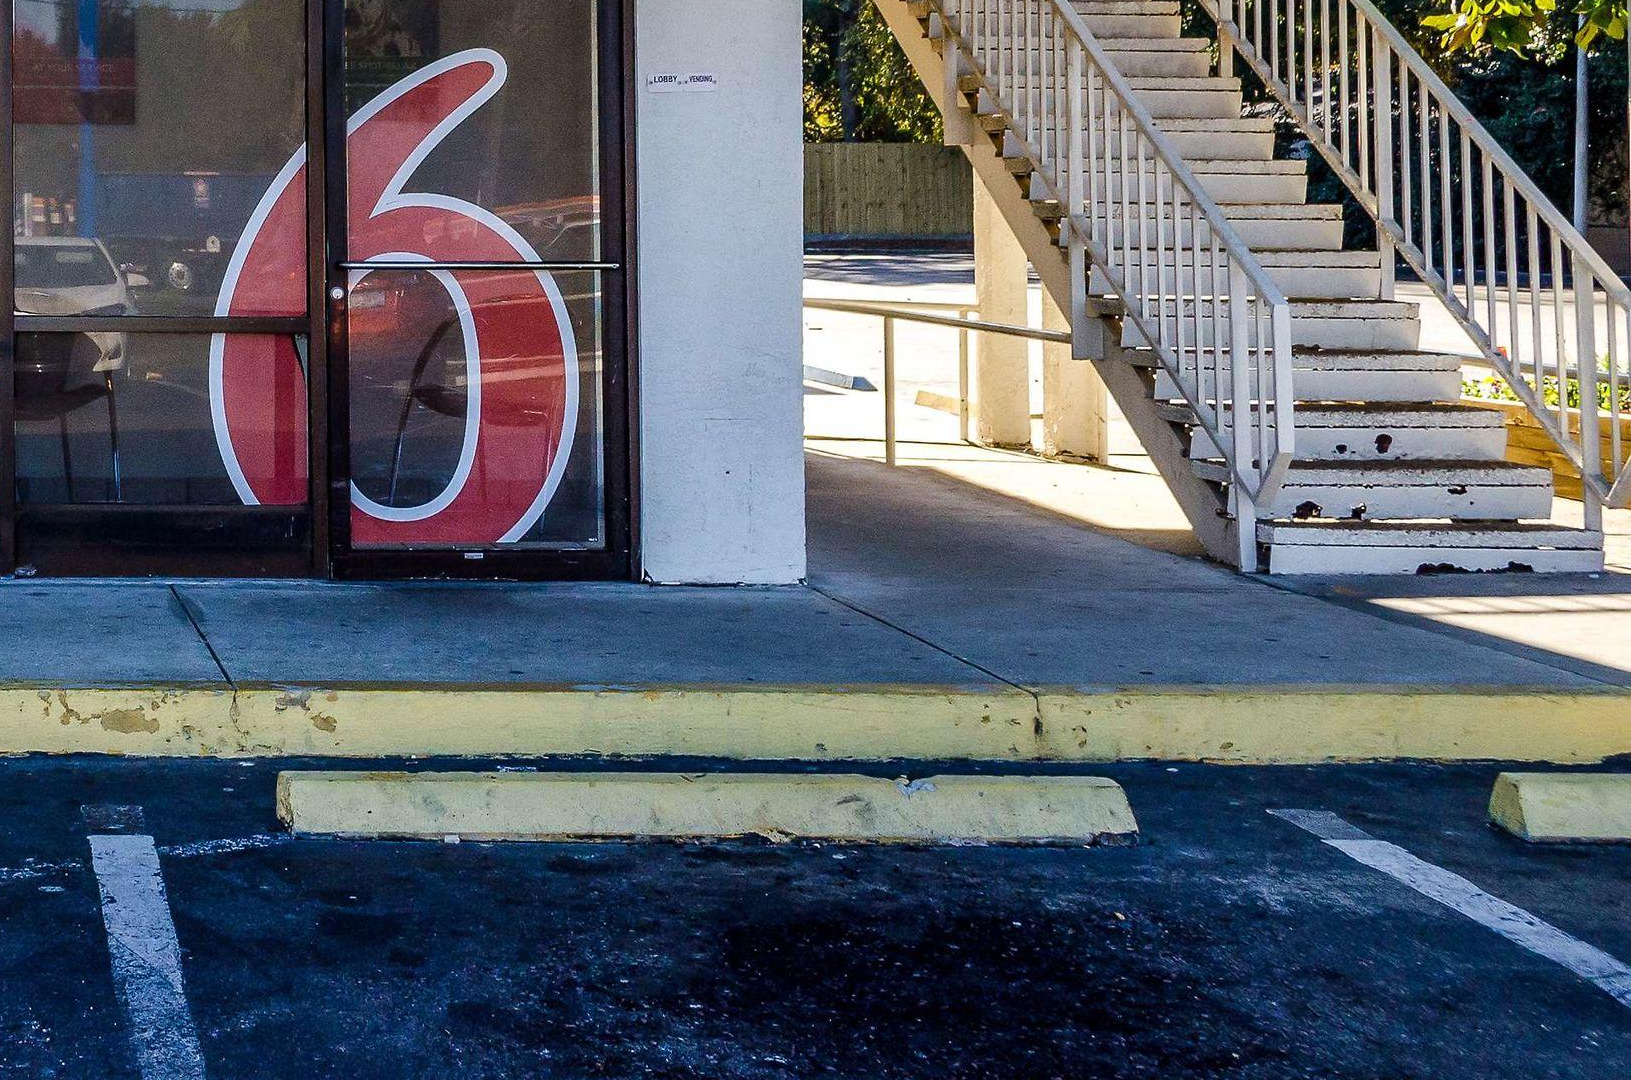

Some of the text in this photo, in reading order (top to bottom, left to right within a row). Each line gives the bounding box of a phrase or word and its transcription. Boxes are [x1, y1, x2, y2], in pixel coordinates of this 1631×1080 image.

[653, 75, 678, 83] LOBBY
[688, 75, 713, 83] VENDING
[209, 47, 580, 545] 6
